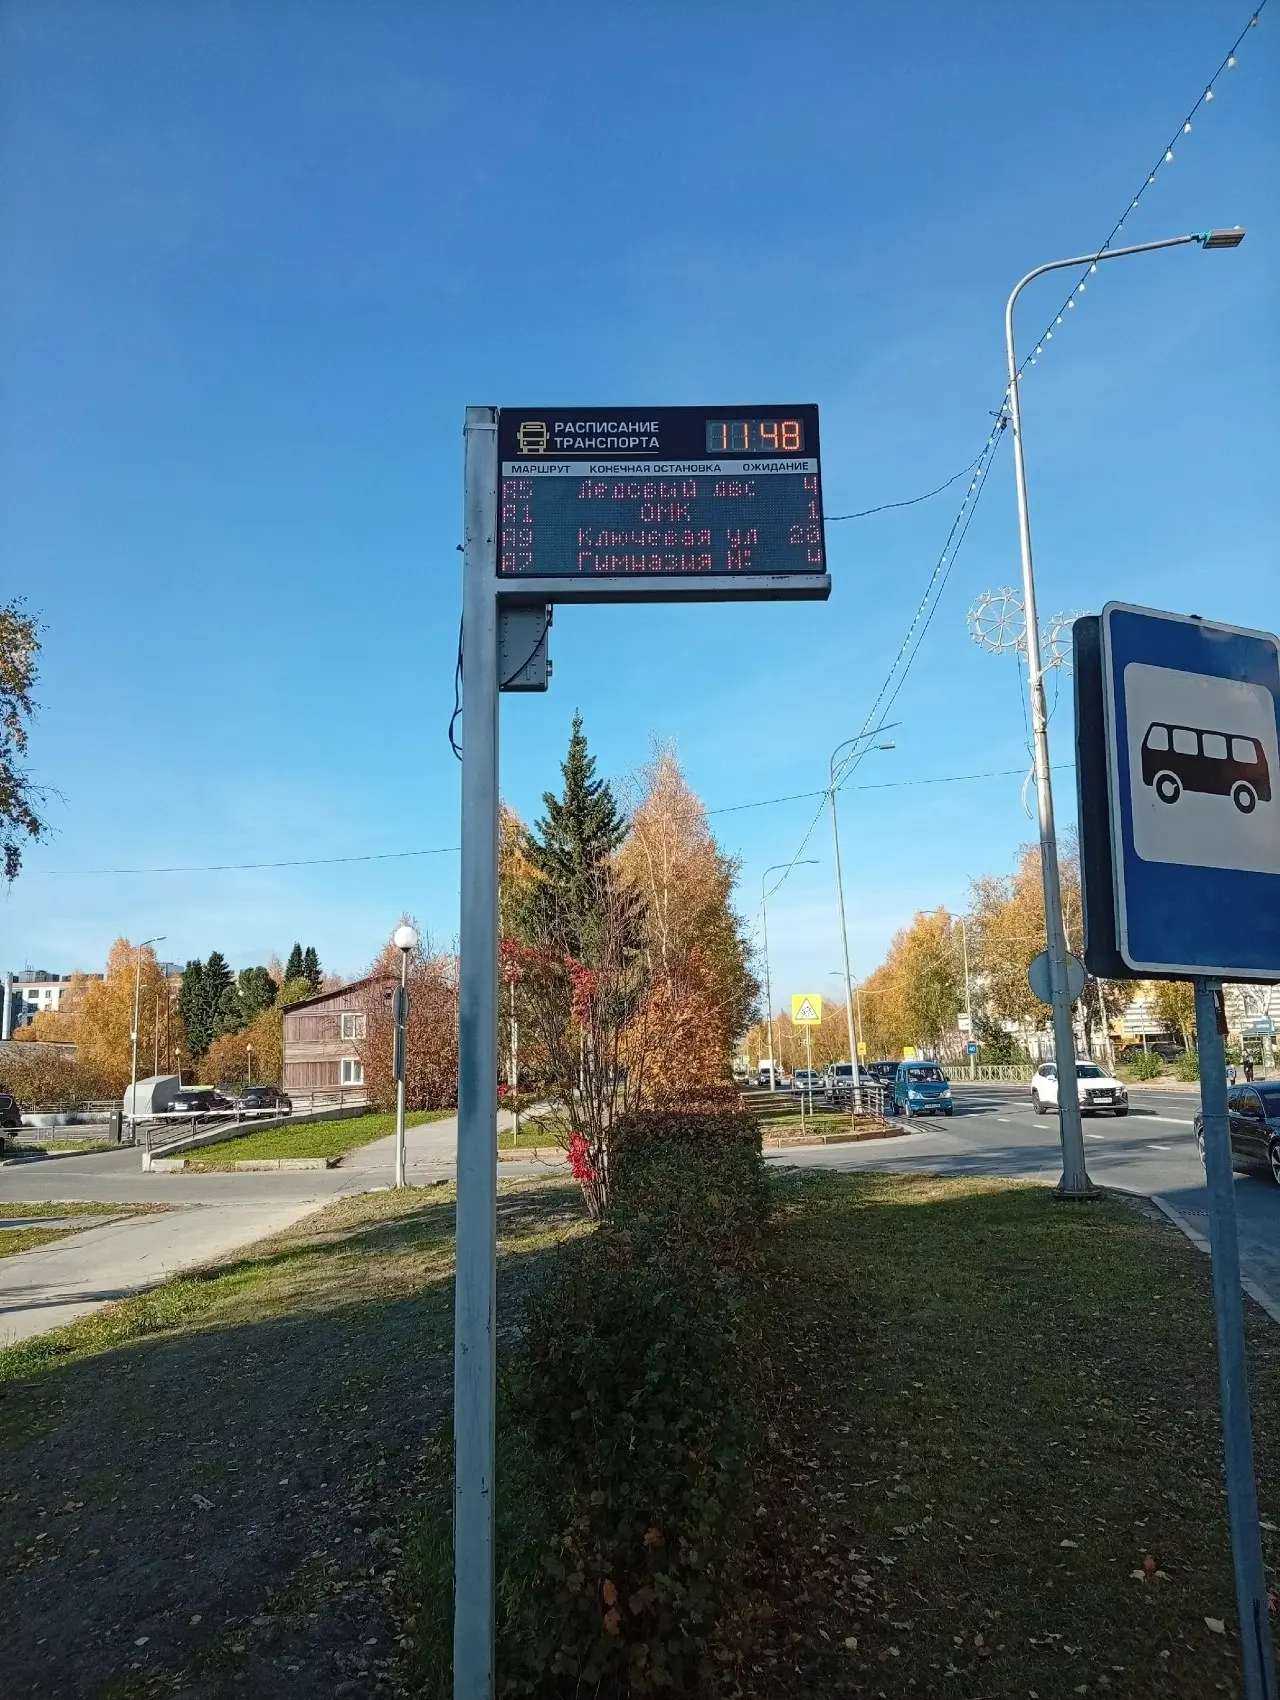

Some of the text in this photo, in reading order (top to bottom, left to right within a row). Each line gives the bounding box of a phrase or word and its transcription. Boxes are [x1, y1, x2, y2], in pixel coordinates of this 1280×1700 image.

[554, 421, 660, 434] РАСПИСАНИЕ
[553, 436, 661, 449] ТРАНСПОРТА
[511, 464, 572, 474] МАРШРУТ
[589, 463, 722, 474] КОНЕЧНАЯ ОСТАНОВКА
[742, 461, 809, 473] ОЖИДАНИЕ
[803, 475, 818, 496] 4
[640, 502, 691, 522] ОМК
[808, 500, 819, 520] 1
[578, 527, 711, 547] Ключевая
[727, 528, 758, 549] ул
